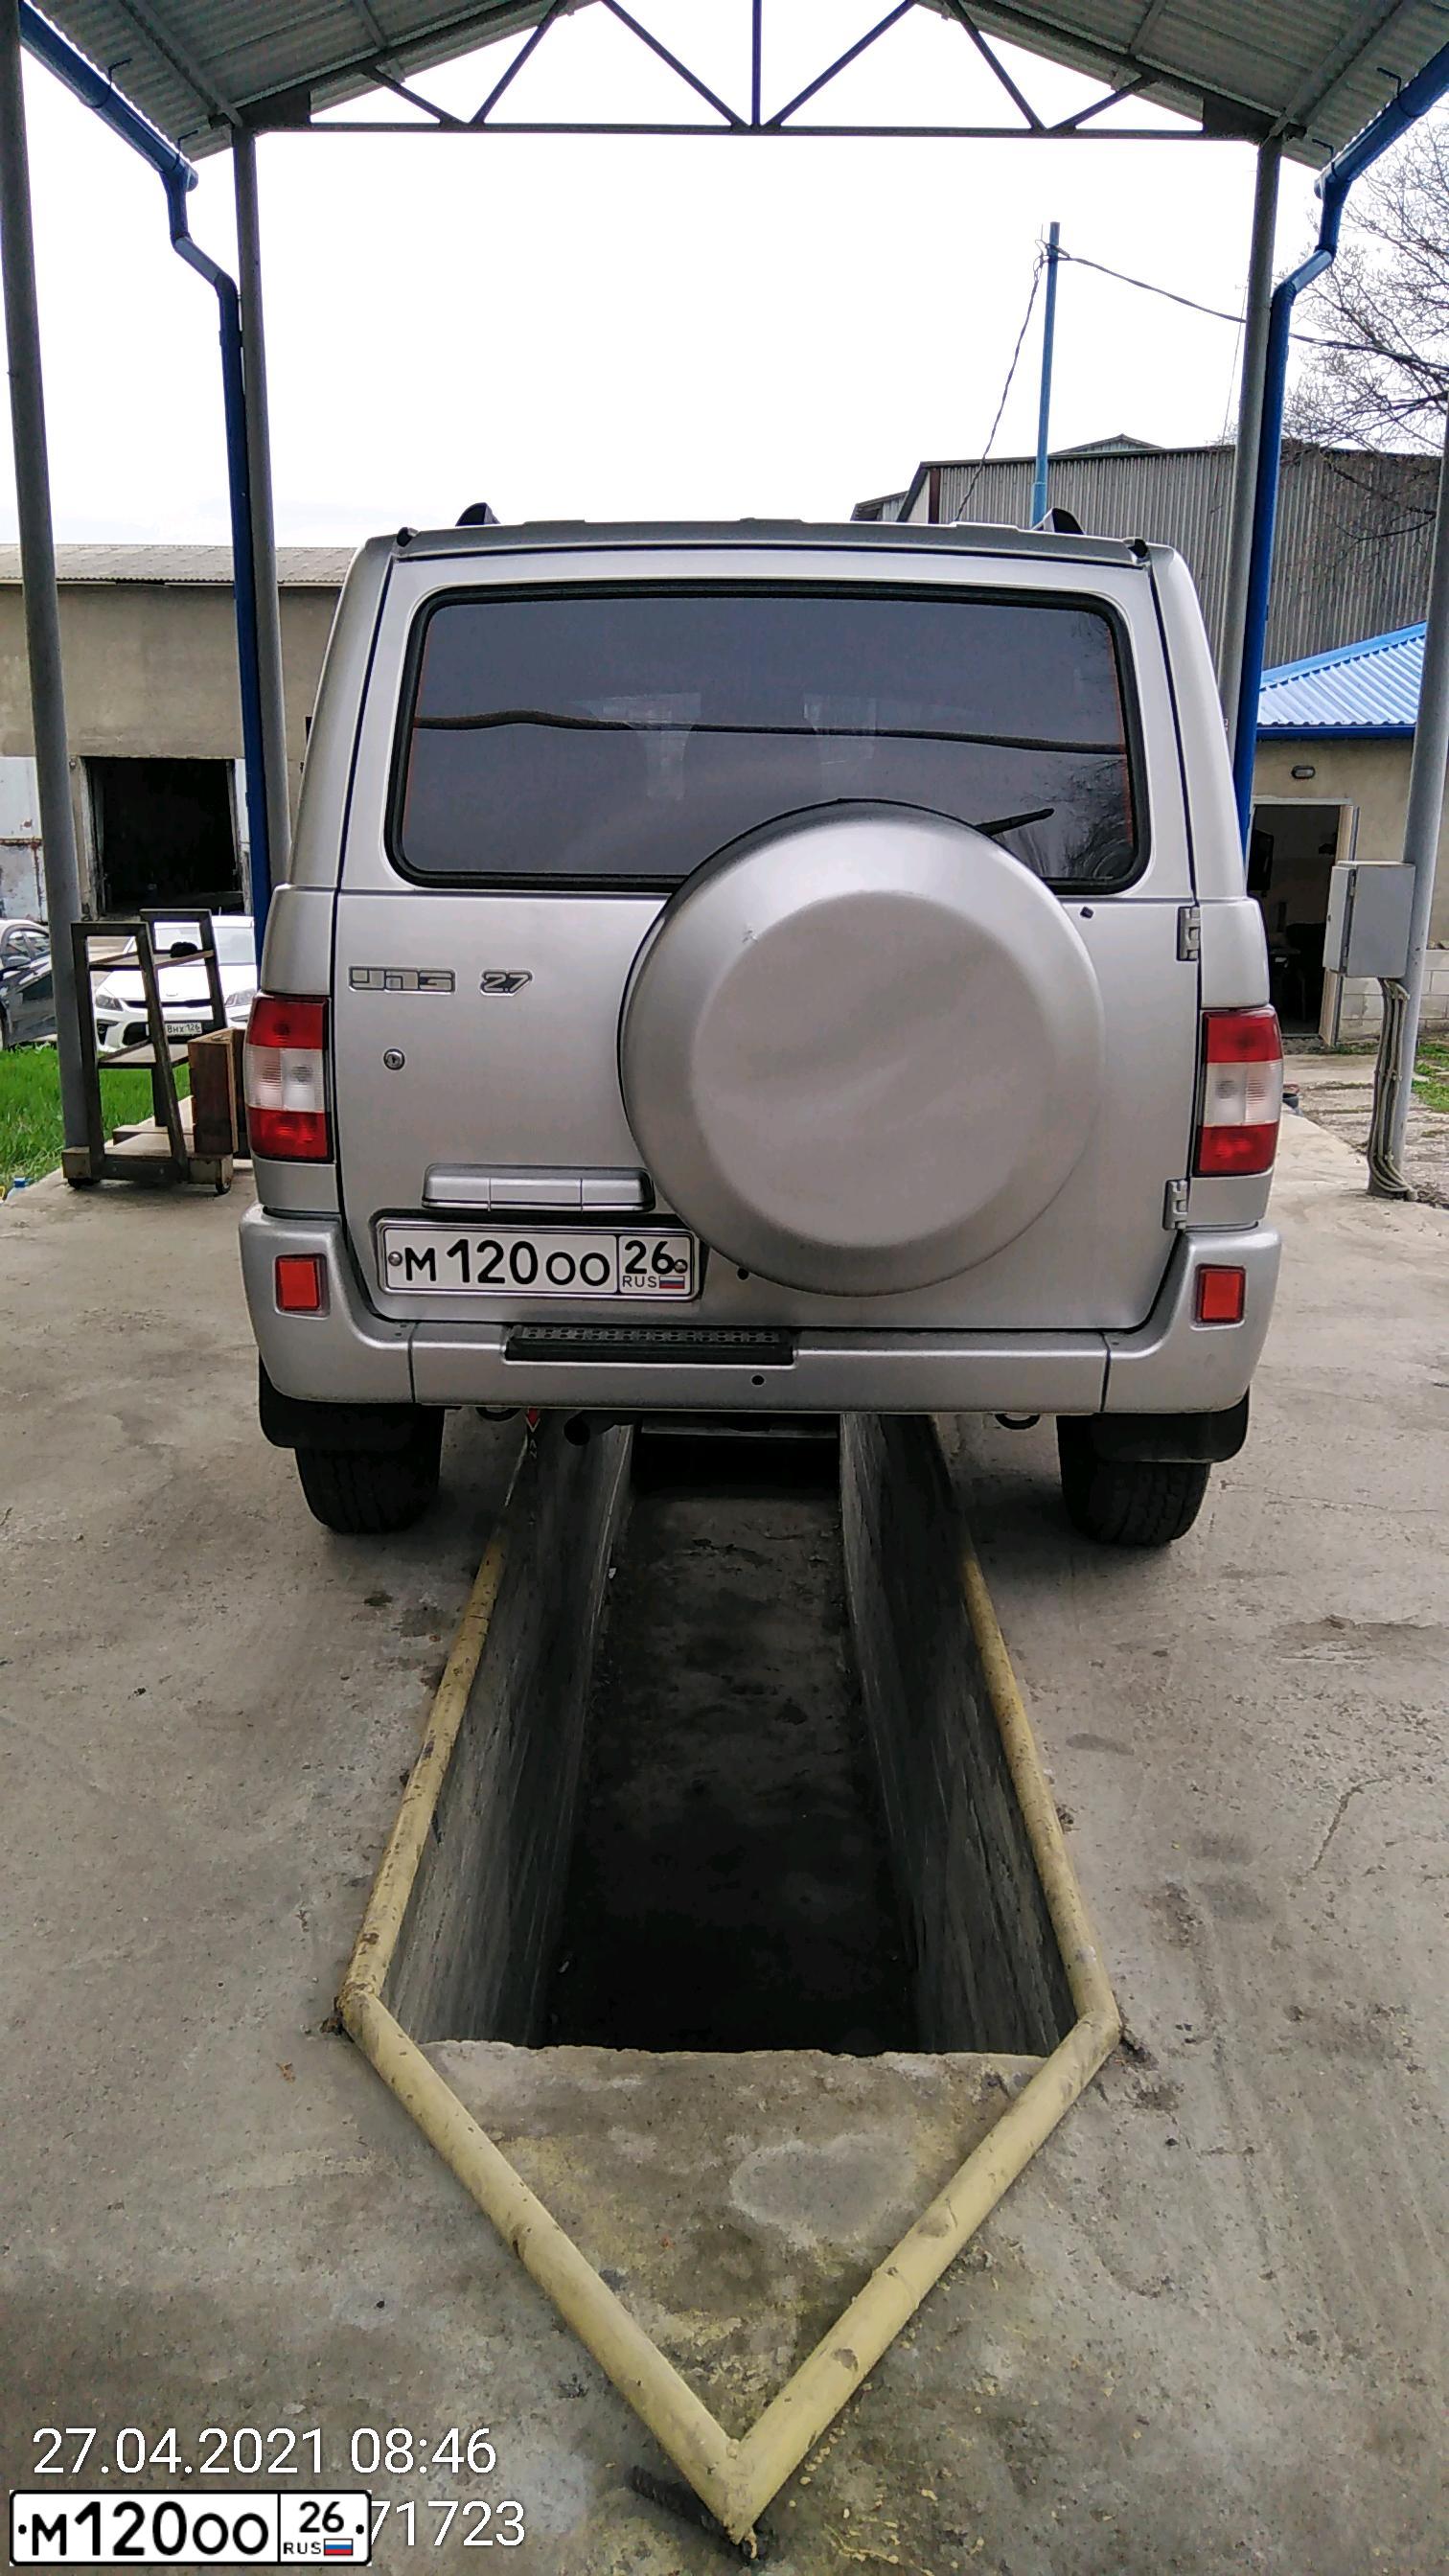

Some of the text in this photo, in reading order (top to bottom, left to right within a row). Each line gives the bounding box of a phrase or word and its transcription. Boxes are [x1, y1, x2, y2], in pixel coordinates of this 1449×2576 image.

[349, 966, 532, 995] УАЗ 2.7
[624, 1239, 675, 1275] 26
[622, 1275, 657, 1289] RUS
